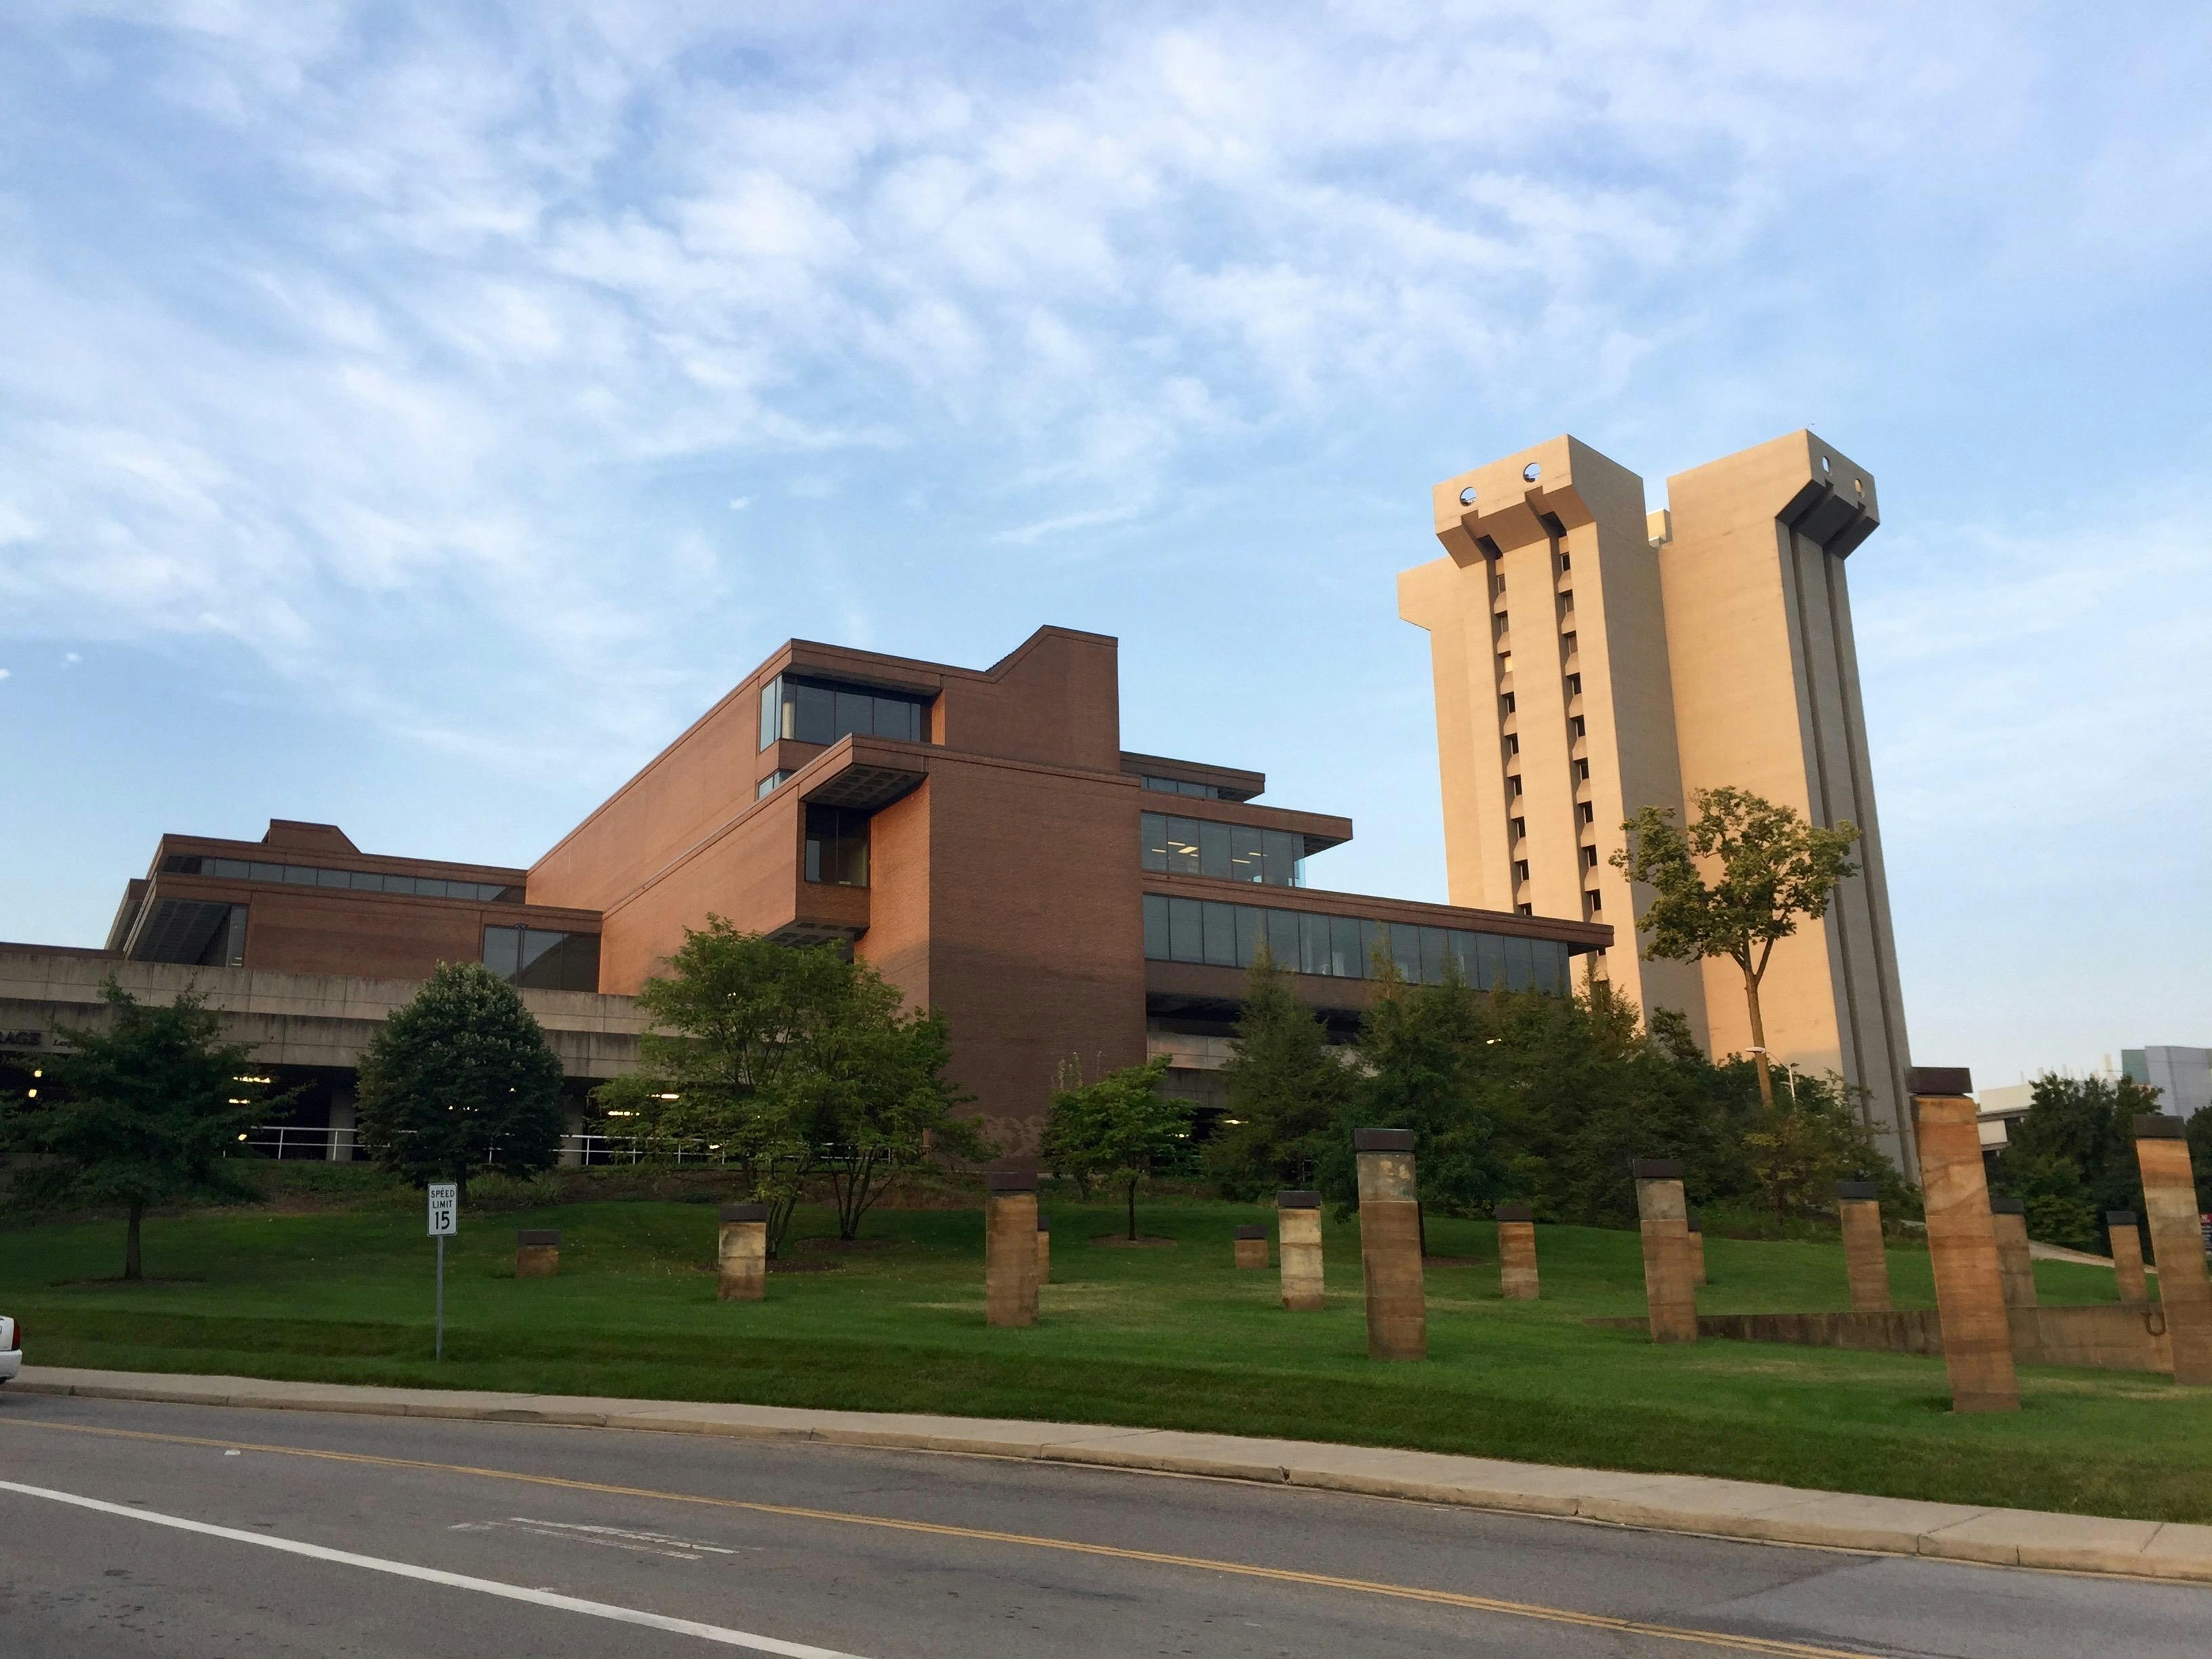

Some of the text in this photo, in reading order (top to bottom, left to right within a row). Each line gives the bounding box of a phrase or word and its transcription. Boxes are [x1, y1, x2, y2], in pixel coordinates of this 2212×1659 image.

[431, 1190, 455, 1198] SPEED
[432, 1200, 453, 1209] LIMIT
[435, 1210, 450, 1230] 15
